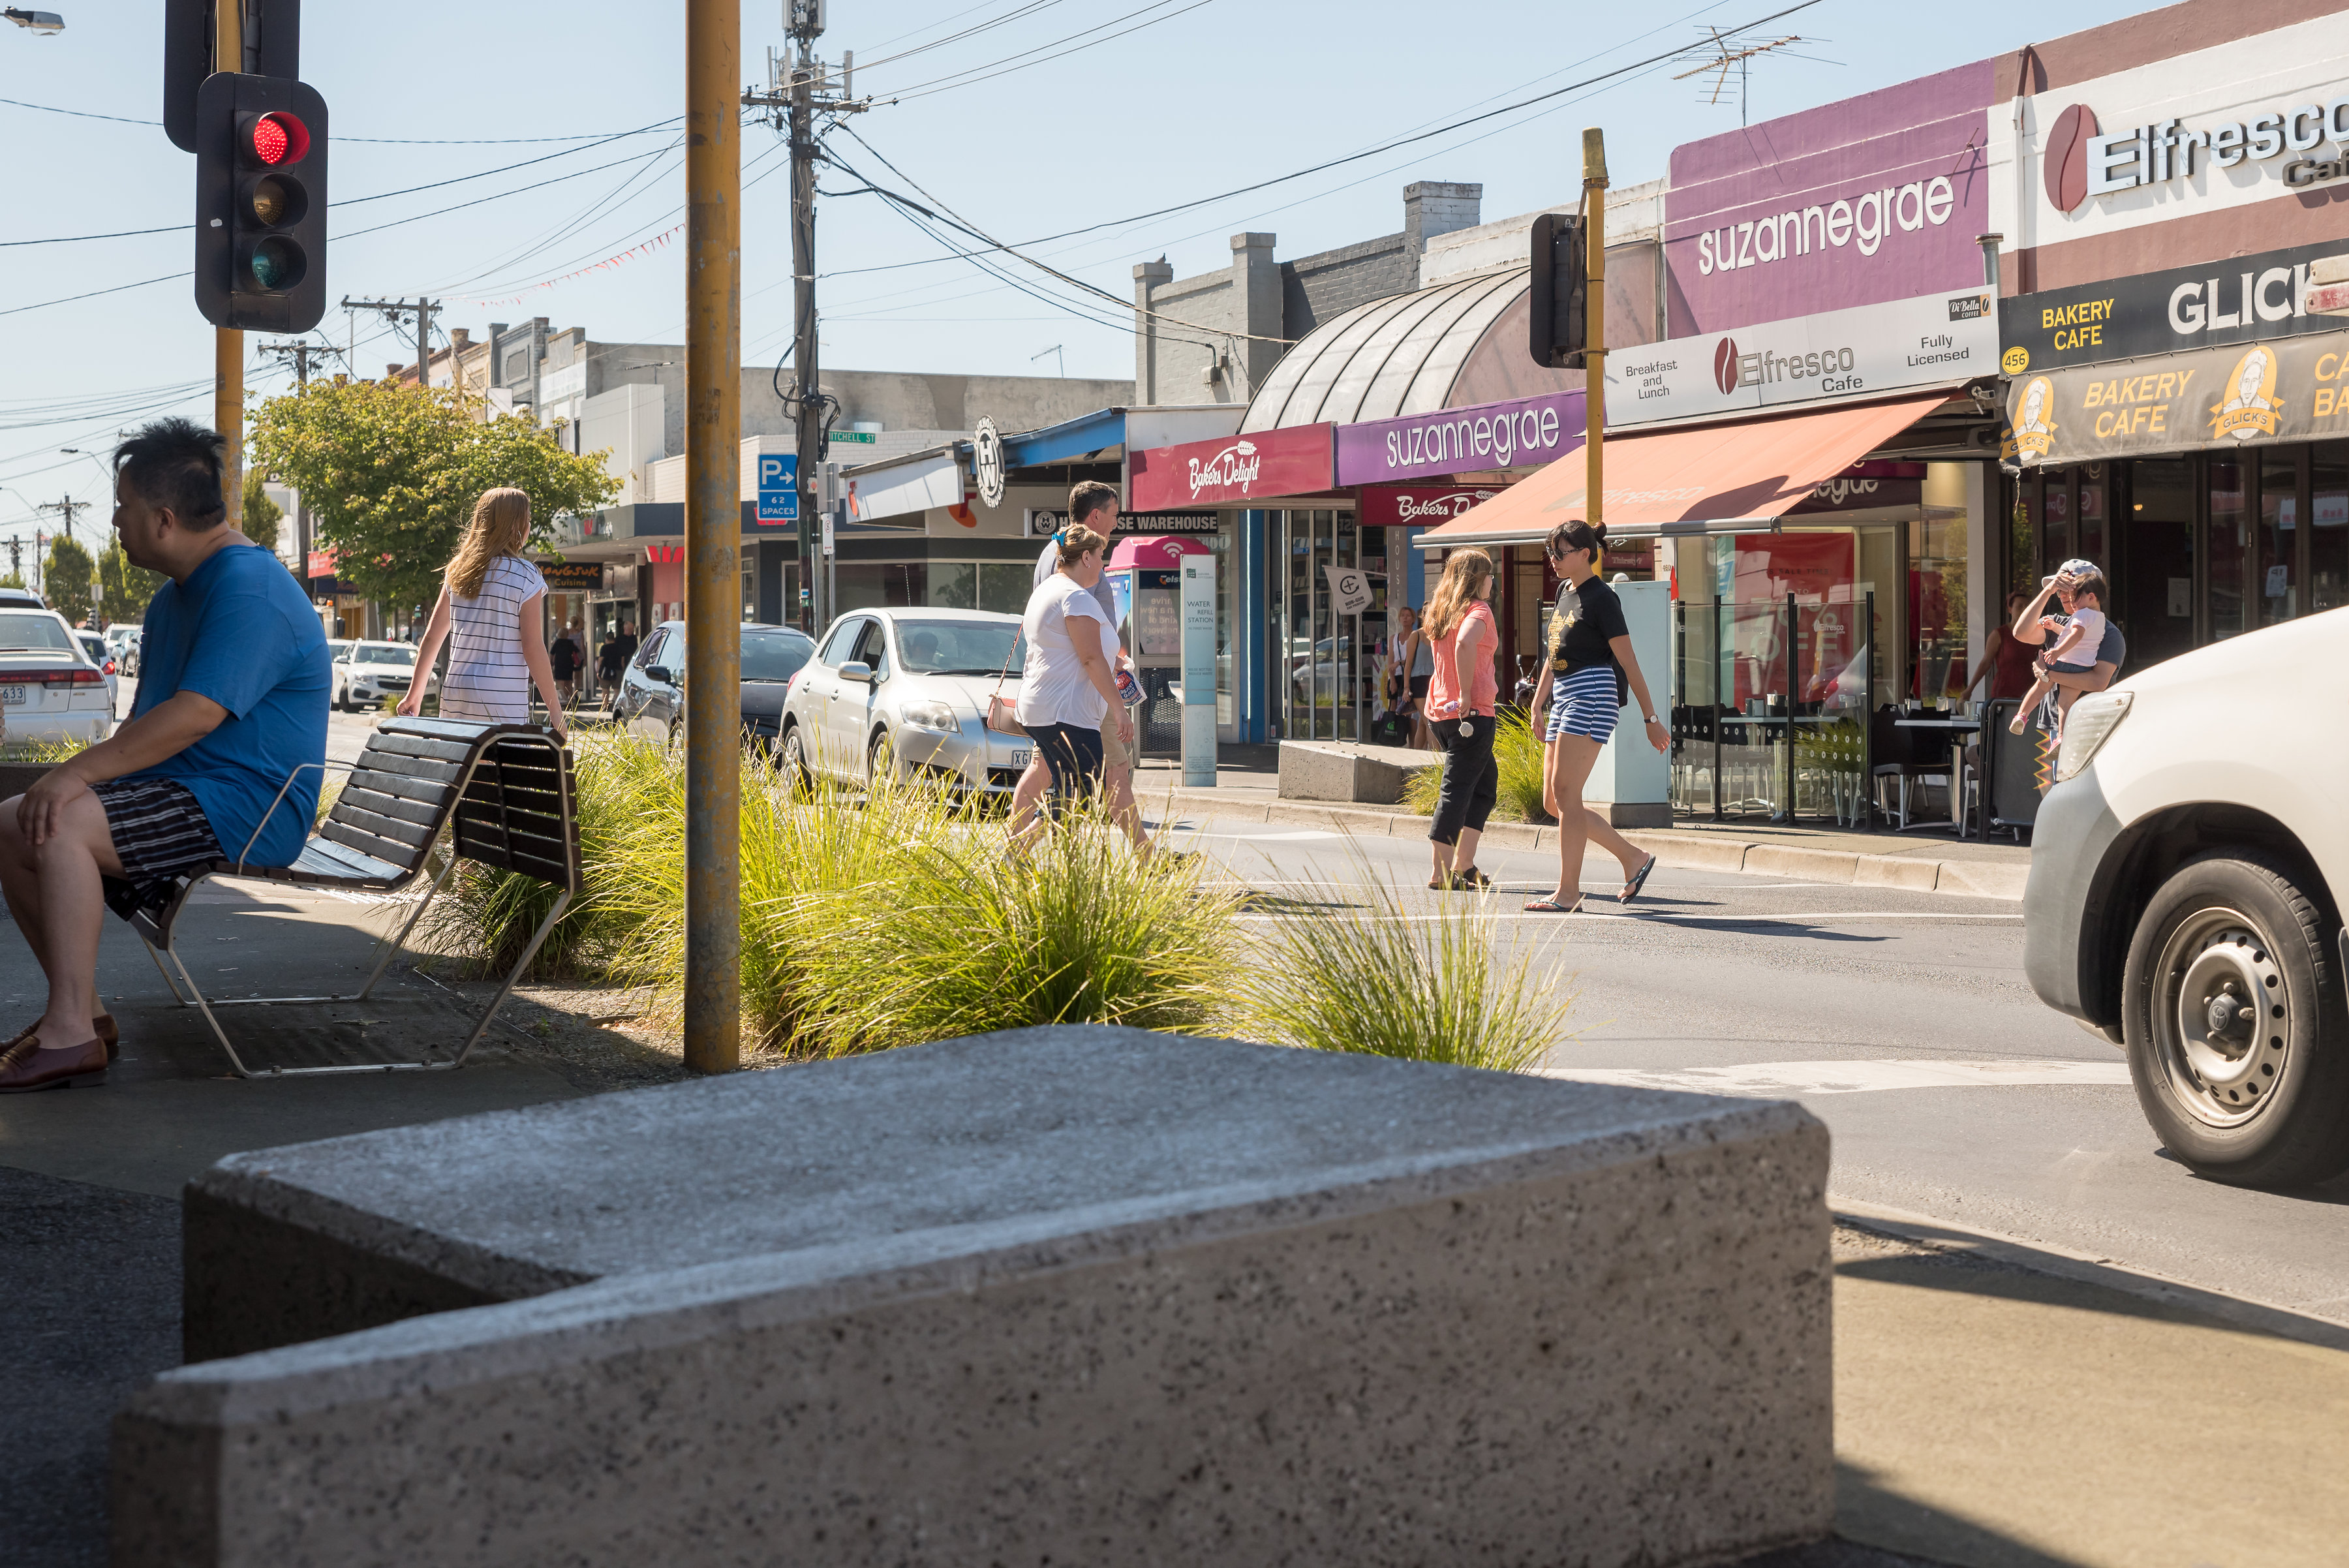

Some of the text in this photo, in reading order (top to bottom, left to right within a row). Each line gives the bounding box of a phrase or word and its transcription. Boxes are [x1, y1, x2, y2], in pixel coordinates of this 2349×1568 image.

[2087, 95, 2349, 196] Elfresco
[1698, 176, 1954, 275] suzannegrae
[2042, 298, 2115, 329] BAKERY
[1920, 333, 1954, 350] Fully
[2054, 324, 2102, 350] CAFE
[1907, 347, 1969, 367] Licensed
[2004, 354, 2026, 367] 456
[1625, 359, 1678, 377] Breakfast
[1736, 347, 1854, 388] Elfresco
[1643, 375, 1663, 386] and
[1822, 375, 1864, 393] Cafe
[2083, 370, 2196, 408] BAKERY
[1638, 384, 1670, 400] Lunch
[2095, 405, 2169, 438] CAFE
[2223, 413, 2268, 429] GLICK'S
[829, 432, 874, 442] ITCHELL ST
[1387, 407, 1560, 467] suzannegrae
[2010, 437, 2045, 452] GLICK'S
[761, 460, 782, 485] P
[1189, 453, 1261, 499] Bakers Delight
[1396, 495, 1449, 522] Bakers
[1137, 516, 1217, 530] WAREHOUSE
[1611, 557, 1642, 566] Thirsty?
[555, 578, 587, 587] Cuisine
[1345, 596, 1364, 607] NON-GUN
[3, 688, 23, 699] 633
